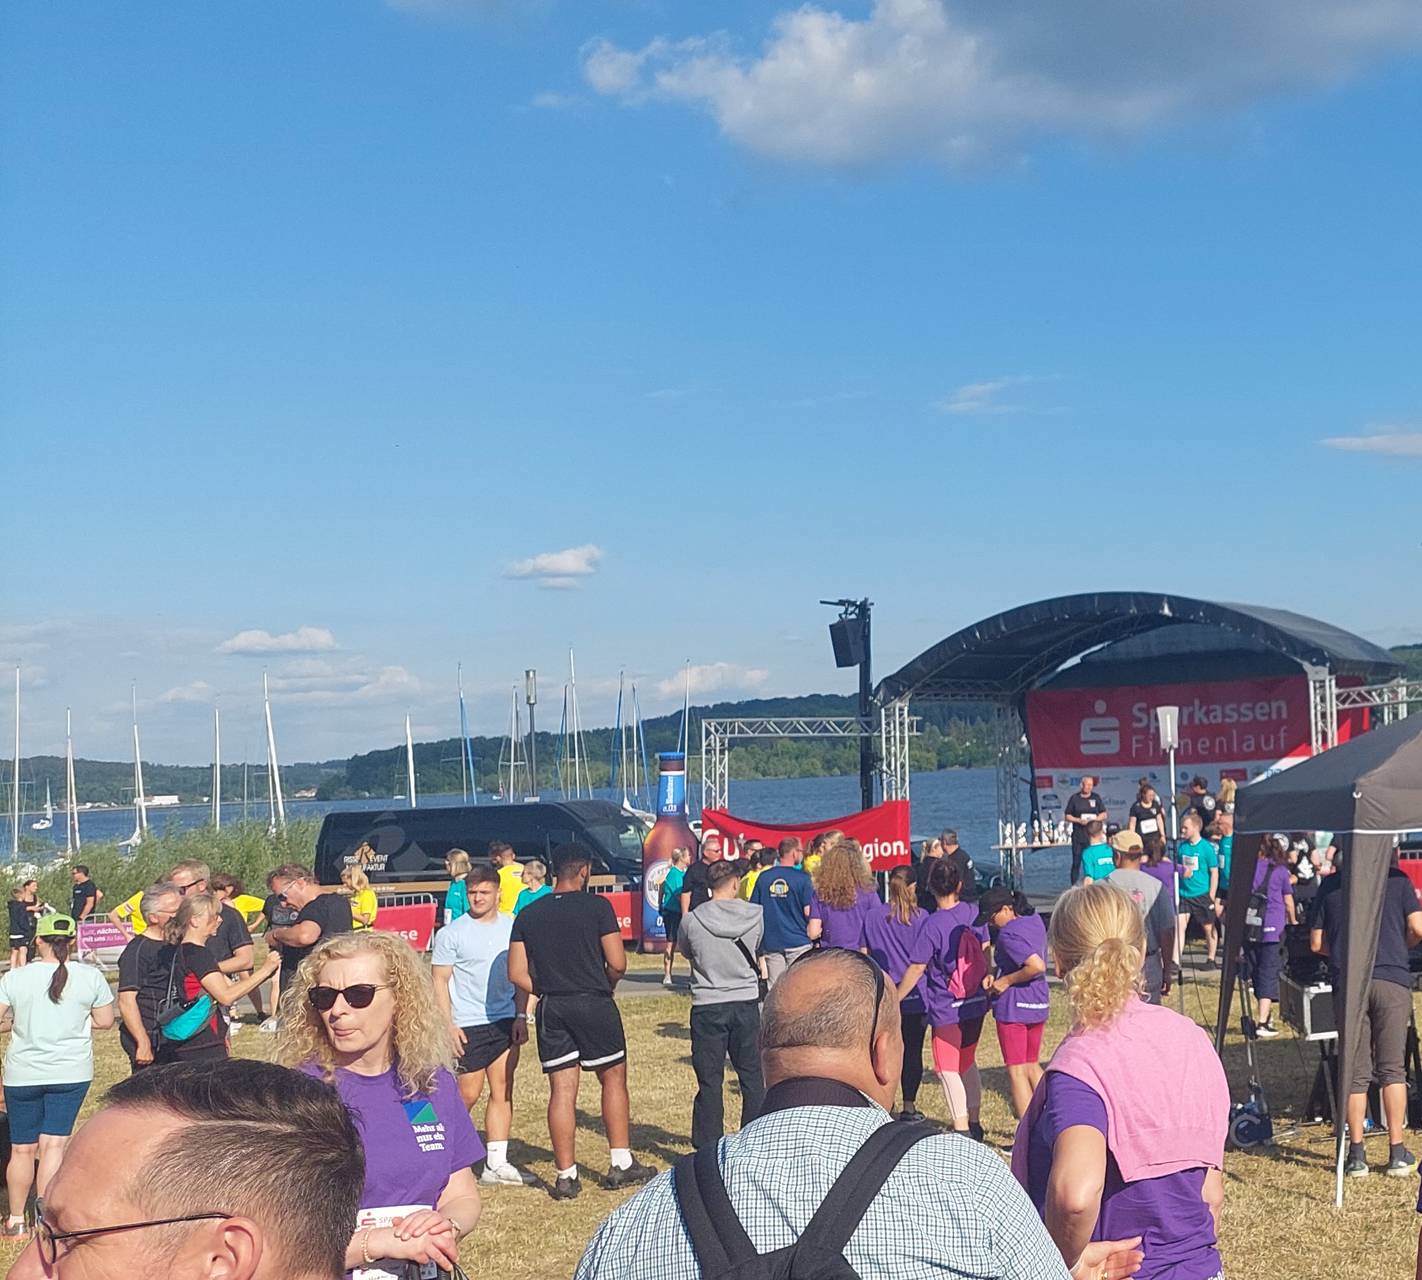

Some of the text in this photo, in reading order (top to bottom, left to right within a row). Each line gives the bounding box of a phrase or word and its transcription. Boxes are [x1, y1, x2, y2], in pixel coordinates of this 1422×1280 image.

[1132, 698, 1288, 734] Sprkassen
[1132, 726, 1288, 759] Fimenlauf
[412, 1124, 435, 1133] Mehr
